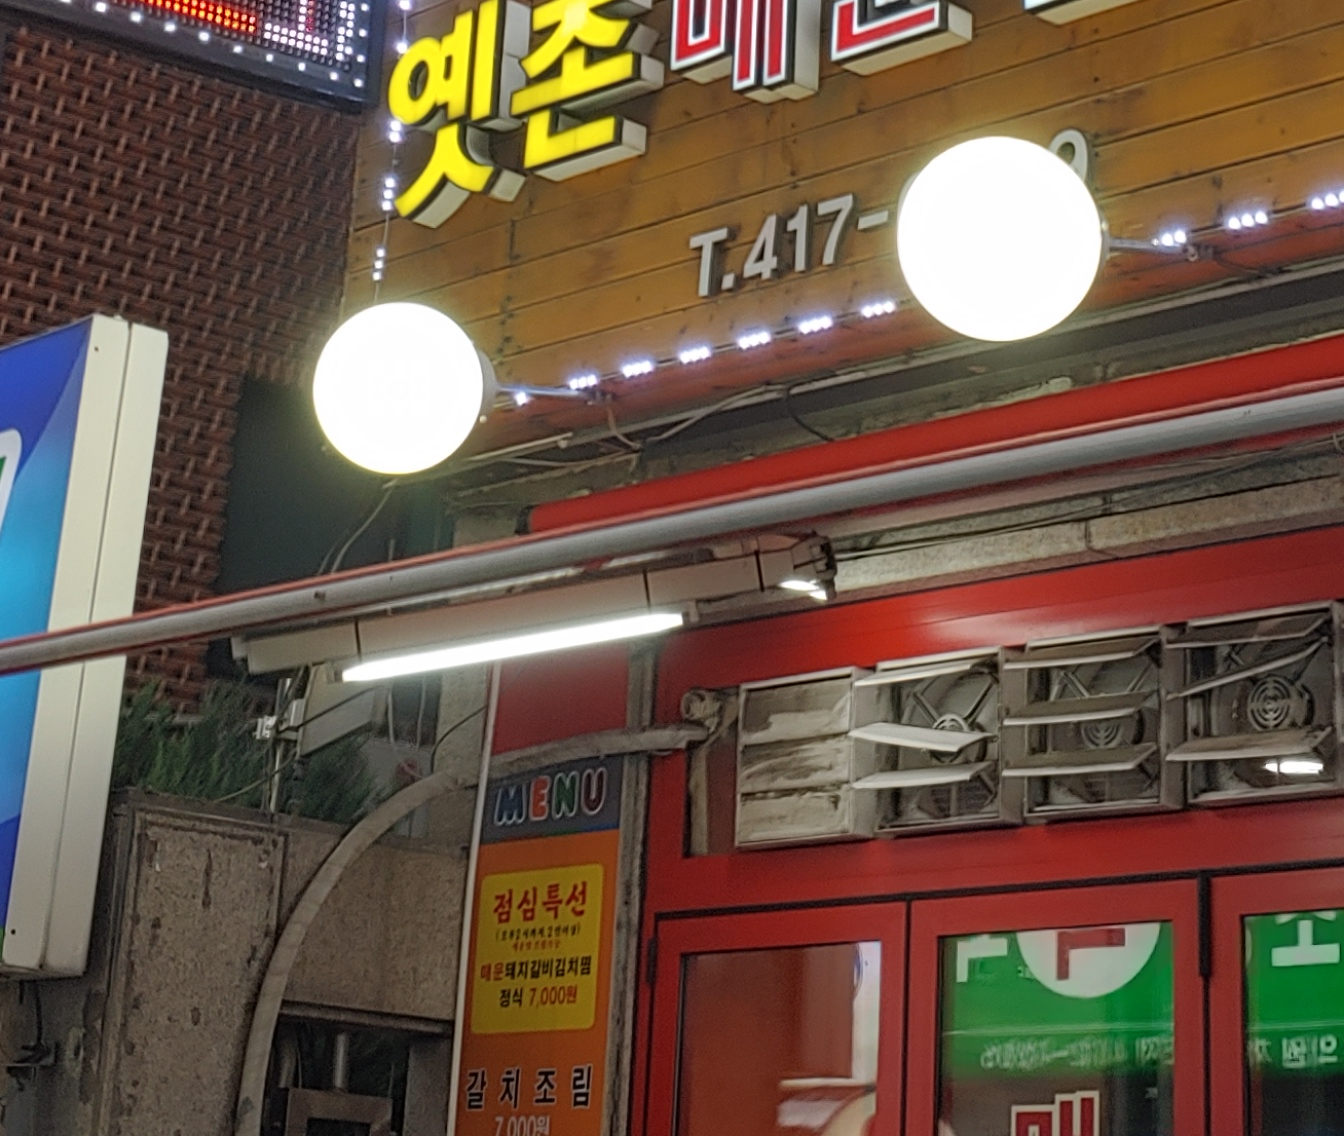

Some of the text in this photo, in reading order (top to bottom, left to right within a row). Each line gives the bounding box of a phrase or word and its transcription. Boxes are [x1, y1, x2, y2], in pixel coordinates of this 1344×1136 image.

[493, 767, 608, 826] MENU
[493, 881, 587, 924] 점심특선
[500, 985, 578, 1008] 정식 7,000원
[467, 1065, 593, 1110] 갈치조림
